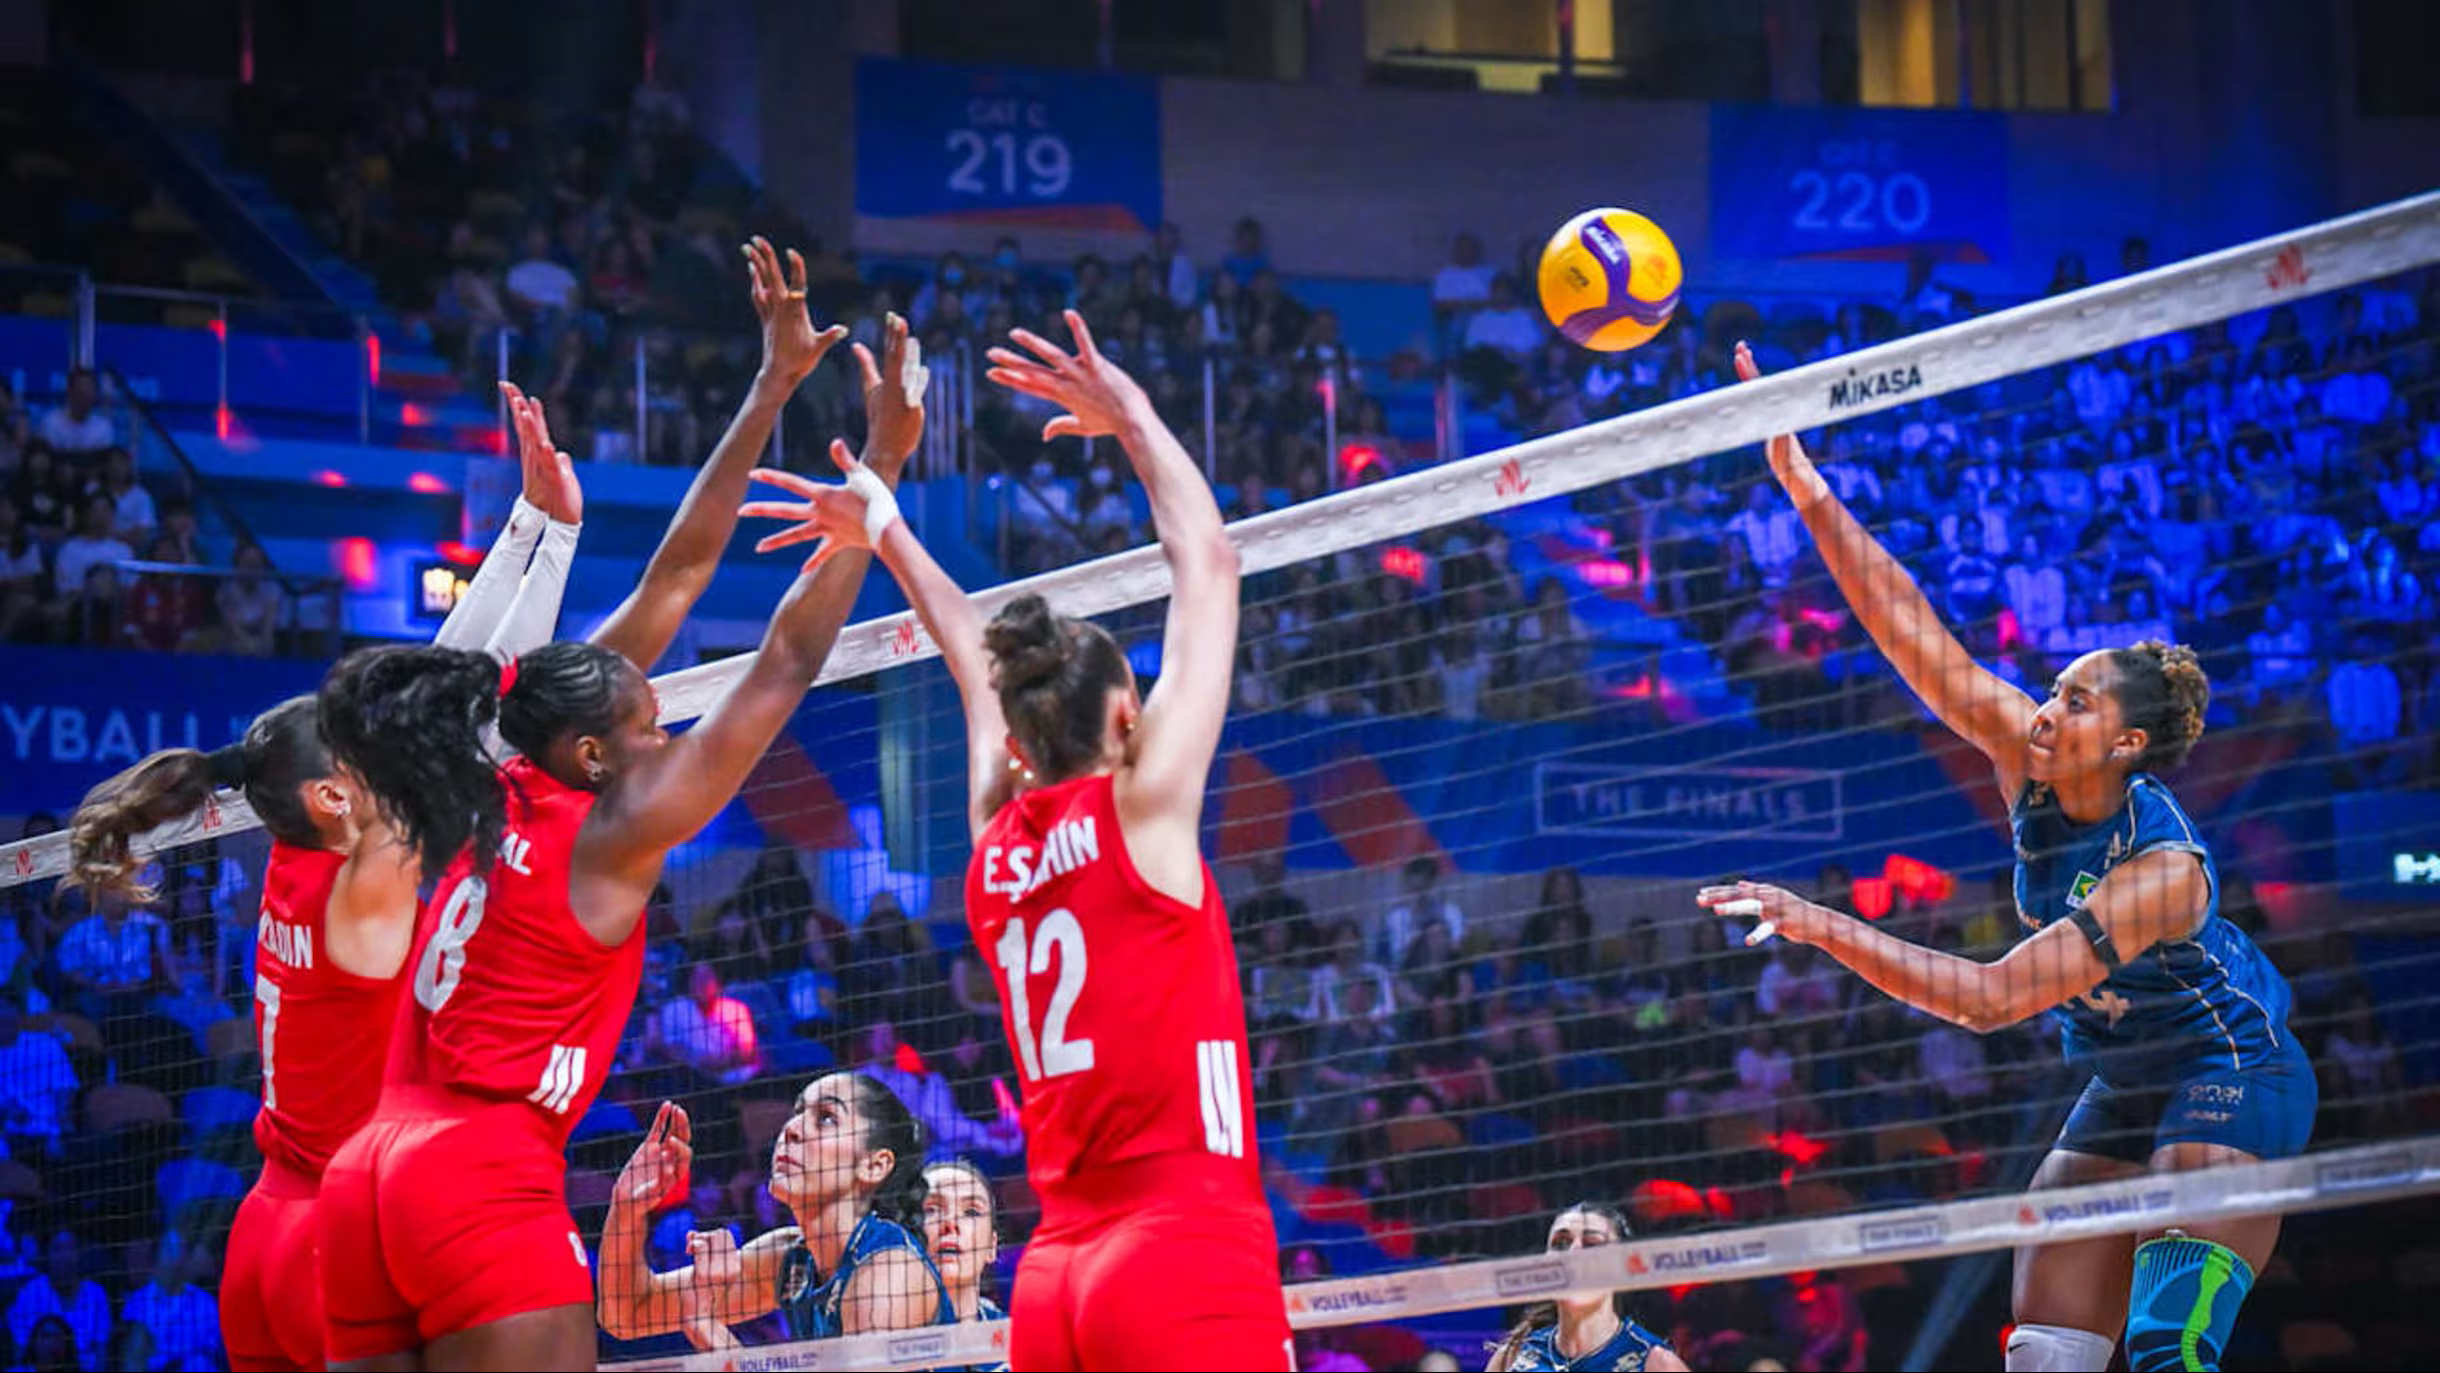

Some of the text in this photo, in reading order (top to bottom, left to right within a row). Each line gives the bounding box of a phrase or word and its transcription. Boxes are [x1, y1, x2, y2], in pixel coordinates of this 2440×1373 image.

[946, 128, 1072, 196] 219
[1790, 169, 1931, 234] 220
[1570, 783, 1810, 822] THE FINALS
[413, 874, 488, 1013] 8
[997, 908, 1095, 1083] 12
[256, 972, 281, 1110] 7
[1311, 1288, 1387, 1313] VOLLEYBALL
